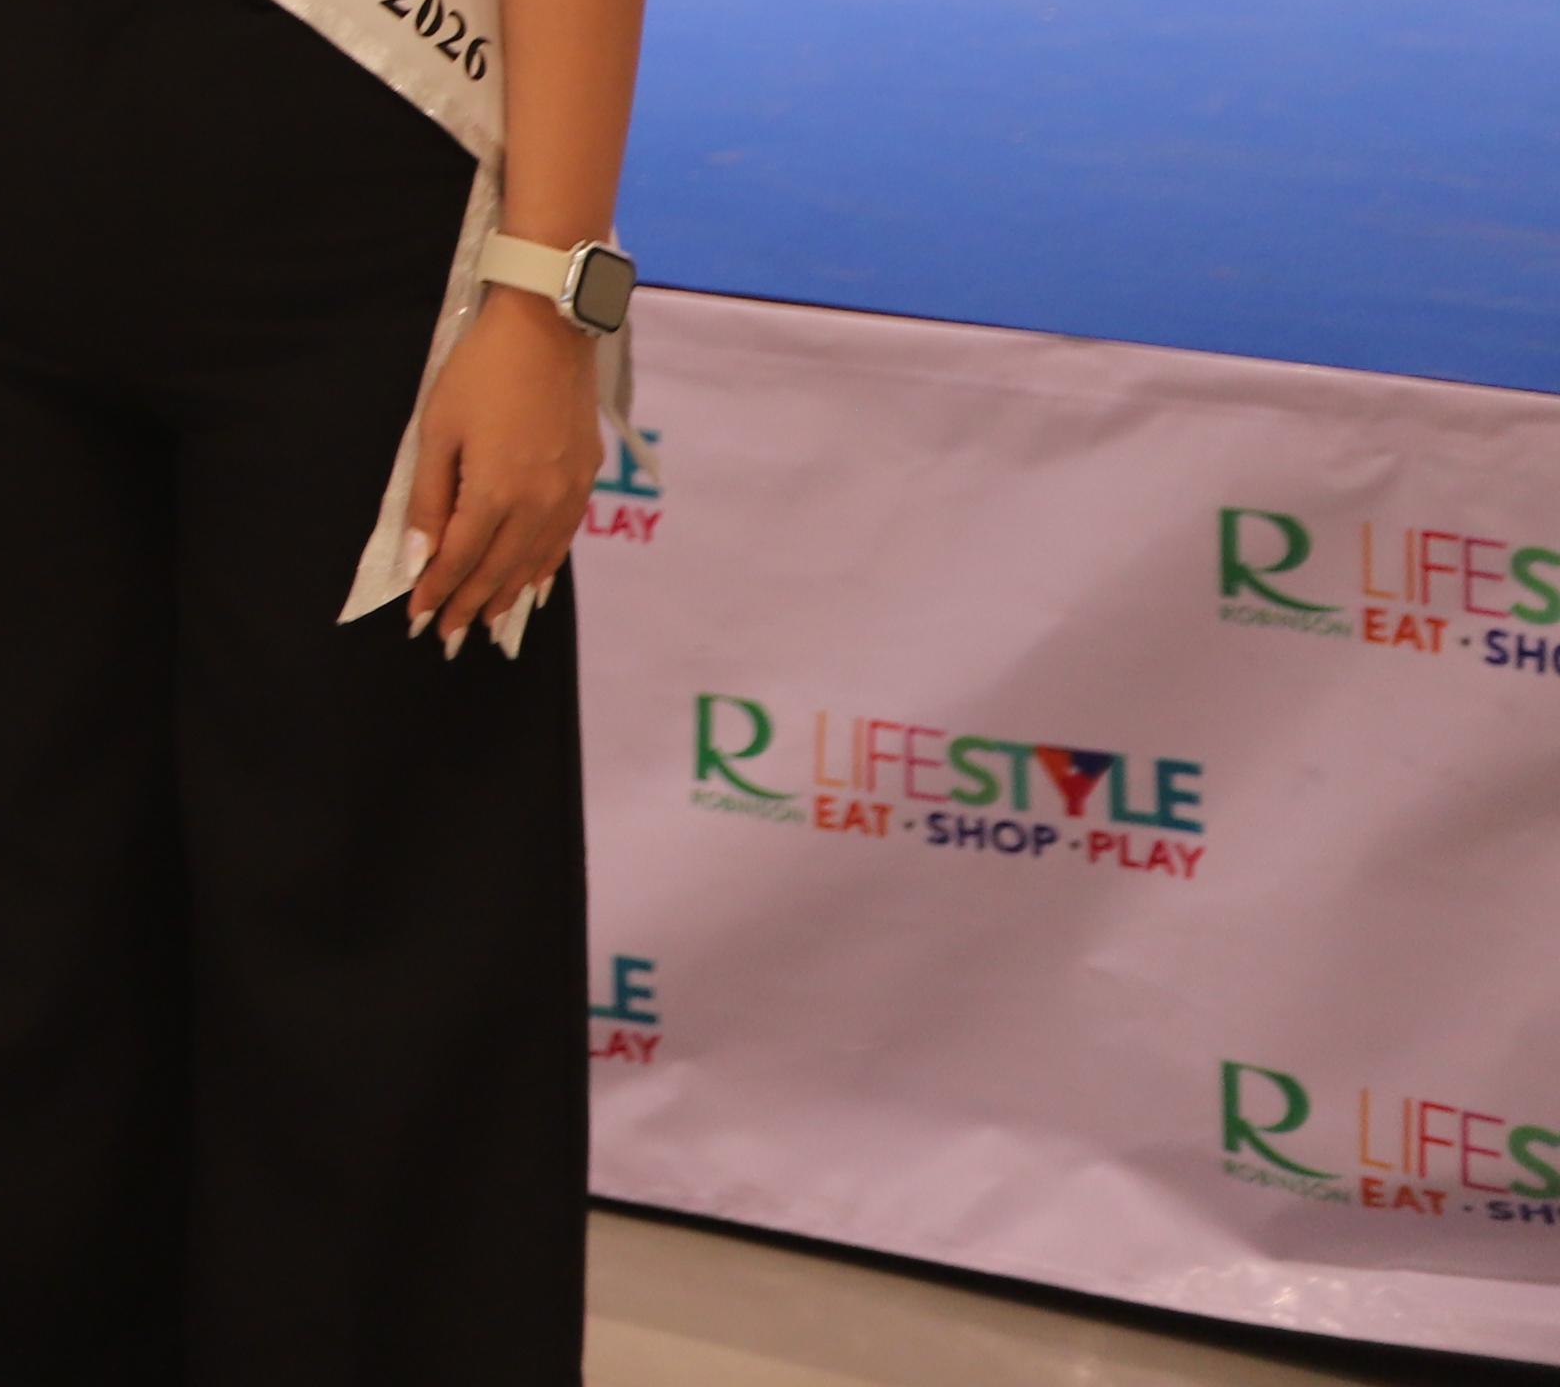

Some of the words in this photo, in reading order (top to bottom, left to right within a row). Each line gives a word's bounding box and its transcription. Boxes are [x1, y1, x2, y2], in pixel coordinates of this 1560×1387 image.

[586, 500, 662, 544] LAY
[1218, 506, 1345, 612] R
[1361, 607, 1449, 655] EAT
[1484, 628, 1560, 678] SH
[694, 691, 802, 801] R
[813, 711, 1205, 834] LIFESTYLE
[813, 795, 892, 838] EAT
[924, 812, 1057, 857] SHOP
[1086, 830, 1206, 880] PLAY
[1220, 1060, 1345, 1180] R
[1360, 1176, 1448, 1215] EAT
[1486, 1200, 1560, 1226] SH
